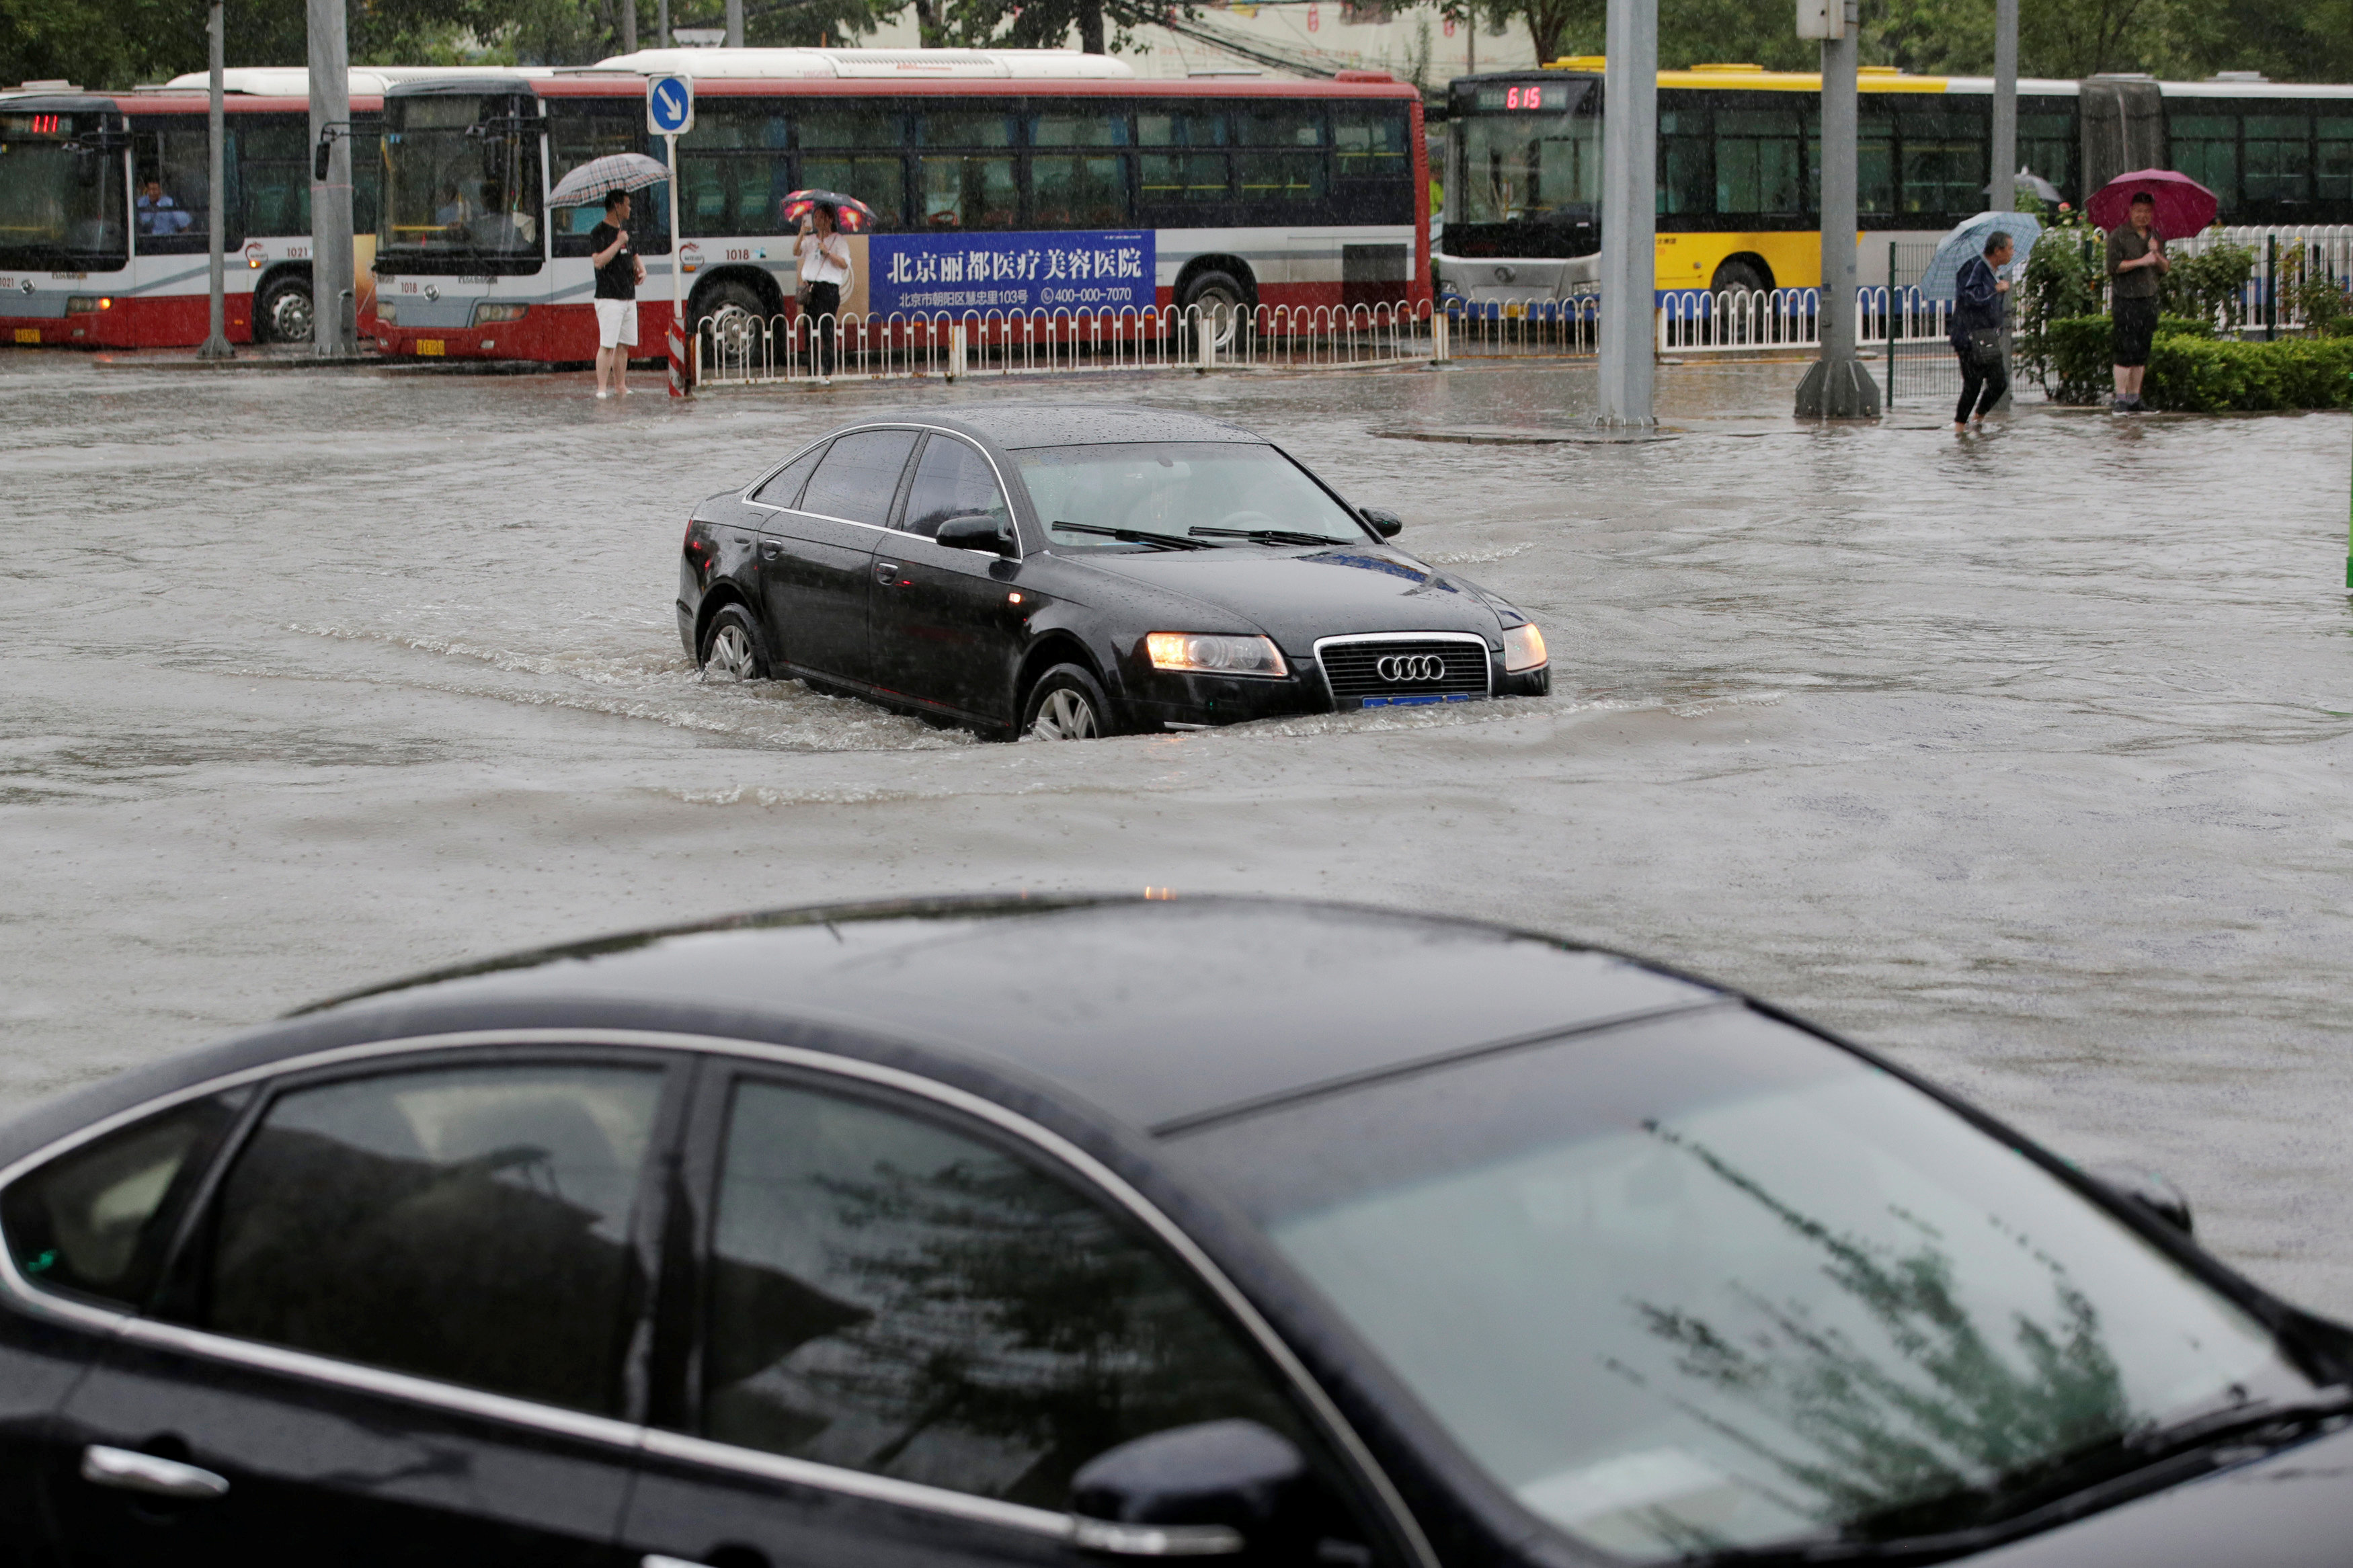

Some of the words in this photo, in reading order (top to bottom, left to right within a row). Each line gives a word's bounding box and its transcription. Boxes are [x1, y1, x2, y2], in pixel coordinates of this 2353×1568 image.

[1507, 86, 1541, 110] 615
[33, 114, 58, 133] 111
[287, 247, 308, 258] 1021
[726, 249, 750, 260] 1018
[887, 247, 1142, 284] 北京丽都医疗美容医院
[401, 282, 417, 294] 1018
[1055, 287, 1132, 302] 400-000-7070
[899, 289, 1029, 308] 北京市朝阳区慧忠里103号
